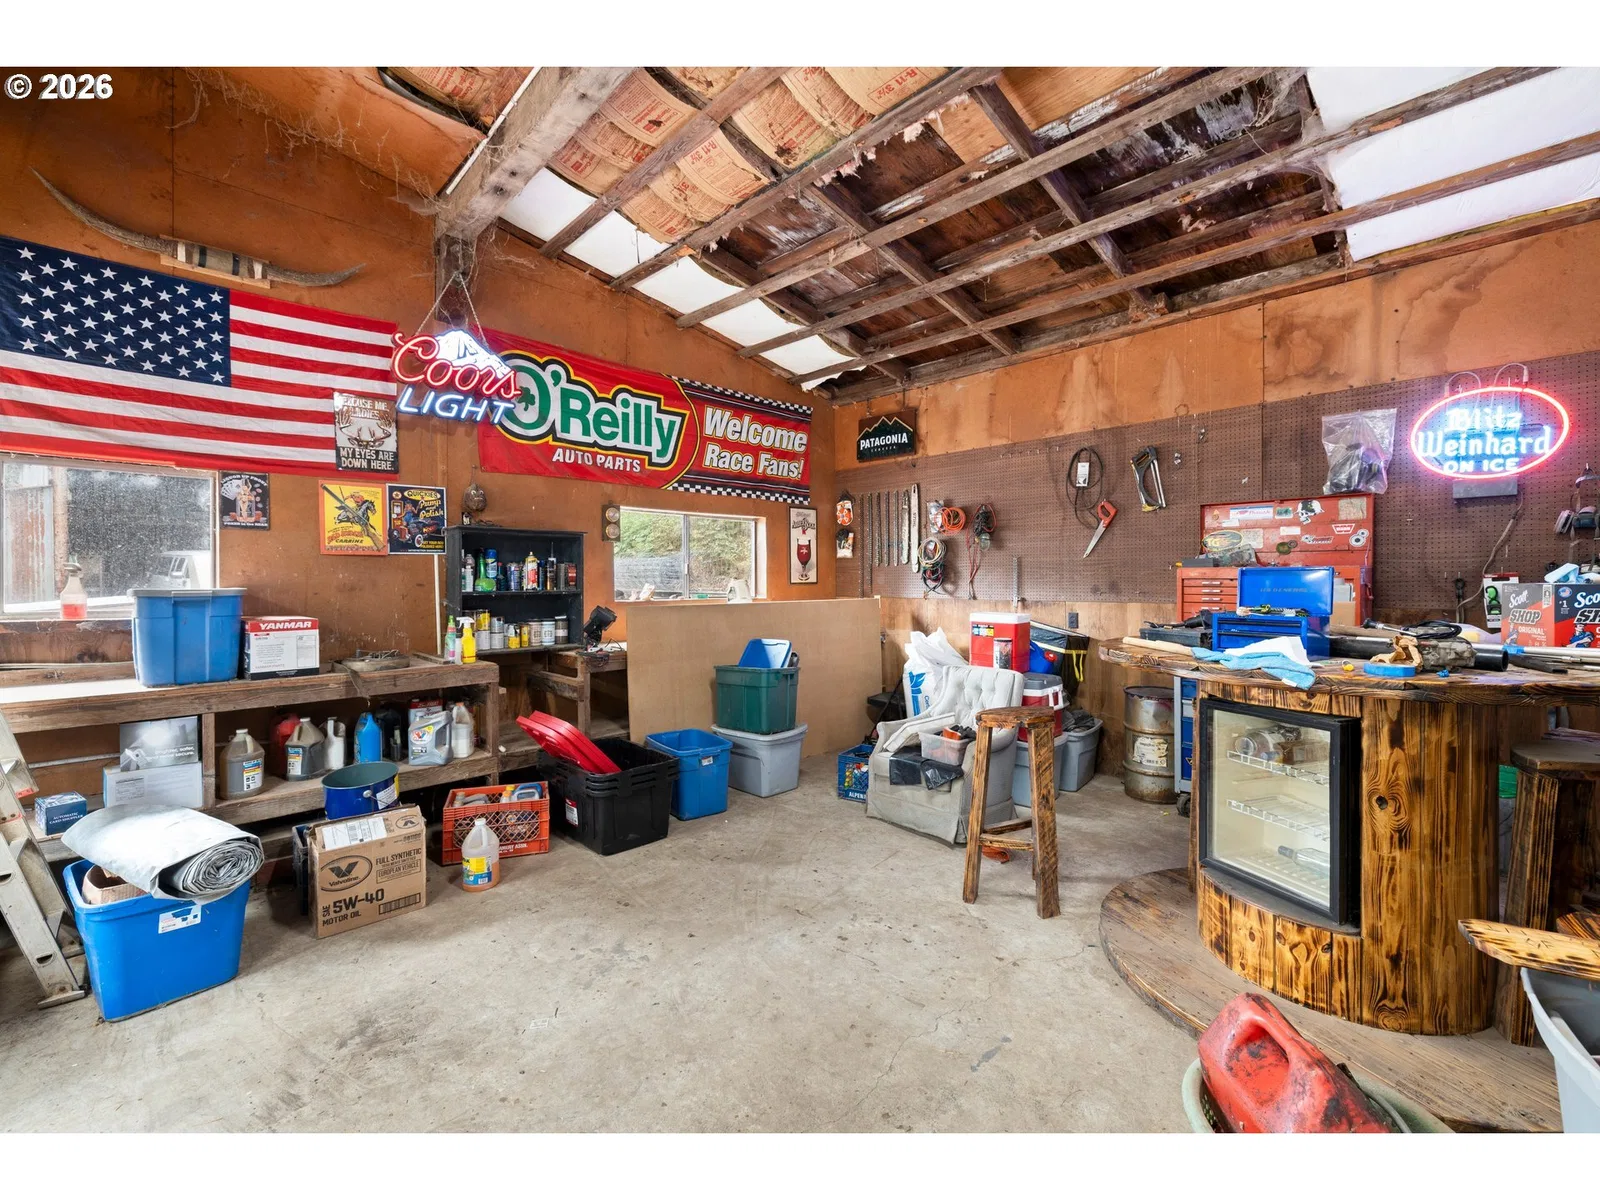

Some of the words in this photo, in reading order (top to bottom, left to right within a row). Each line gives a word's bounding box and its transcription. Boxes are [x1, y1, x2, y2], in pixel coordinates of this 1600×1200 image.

[895, 69, 918, 86] R-11
[702, 140, 718, 155] R-11
[391, 331, 521, 399] Coors
[398, 387, 515, 424] LIGHT
[498, 361, 679, 463] O'Reilly
[1445, 406, 1523, 431] Blitz
[703, 406, 808, 452] Welcome
[860, 432, 908, 451] PATAGONIA
[1417, 426, 1550, 457] Weinhard
[340, 447, 354, 458] MY
[355, 448, 376, 460] EYES
[378, 452, 394, 461] ARE
[552, 448, 593, 466] AUTO
[596, 454, 641, 473] PARTS
[703, 443, 753, 473] Race
[758, 452, 804, 480] Fans!
[341, 457, 367, 468] DOWN
[370, 461, 395, 470] HERE.
[1443, 460, 1474, 473] ON
[1483, 458, 1519, 472] ICE
[407, 490, 438, 498] QUICKIES
[1509, 609, 1541, 624] SHOP
[259, 621, 312, 630] YANMAR
[1518, 626, 1545, 635] ORIGINAL
[376, 856, 389, 865] FULL
[391, 847, 421, 862] SYNTHETIC
[402, 860, 419, 871] VEHICLE
[328, 876, 359, 887] Valvoline
[332, 888, 384, 914] 5W-40
[322, 904, 331, 918] SAE
[322, 914, 349, 927] MOTOR
[350, 910, 361, 918] OIL
